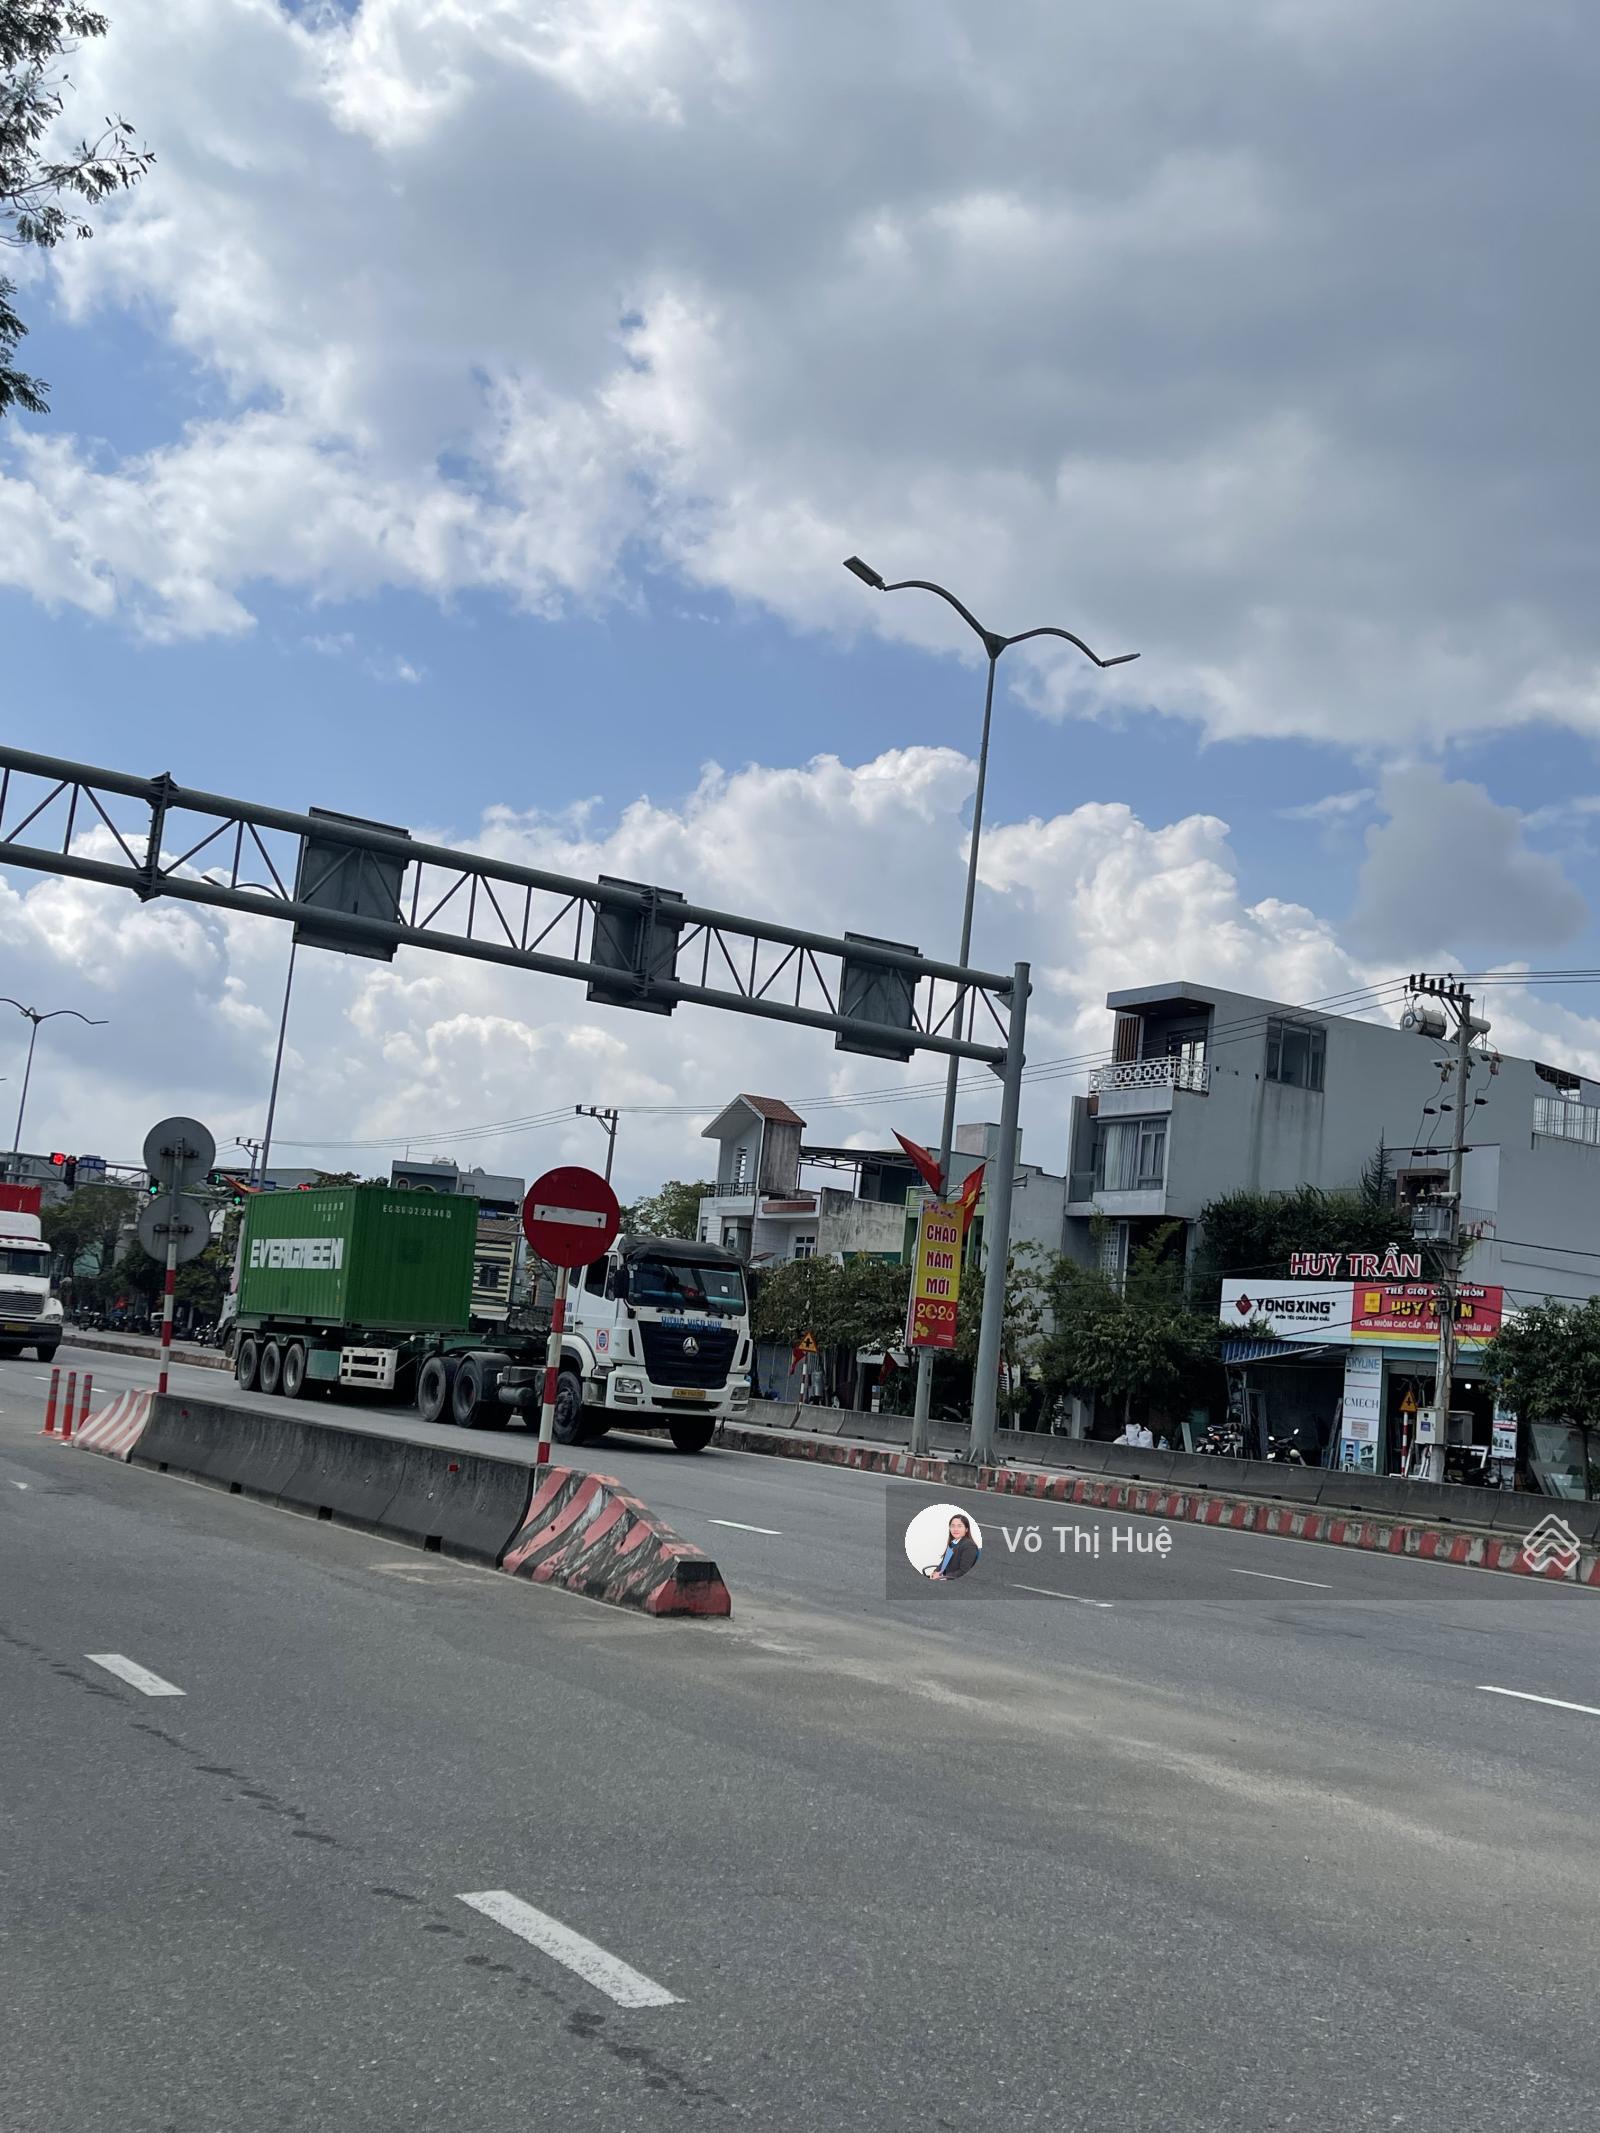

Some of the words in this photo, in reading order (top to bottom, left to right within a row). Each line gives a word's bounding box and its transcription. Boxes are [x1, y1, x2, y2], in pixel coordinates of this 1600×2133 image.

[250, 1238, 344, 1269] EVERGREEN
[926, 1250, 953, 1269] NĂM
[1290, 1252, 1342, 1276] HUY
[1346, 1242, 1422, 1277] TRẦN
[926, 1275, 950, 1295] MỚI
[917, 1303, 954, 1321] 2026
[1256, 1299, 1330, 1313] YONGXING
[1391, 1301, 1423, 1316] HUY
[1344, 1397, 1379, 1409] CMECH
